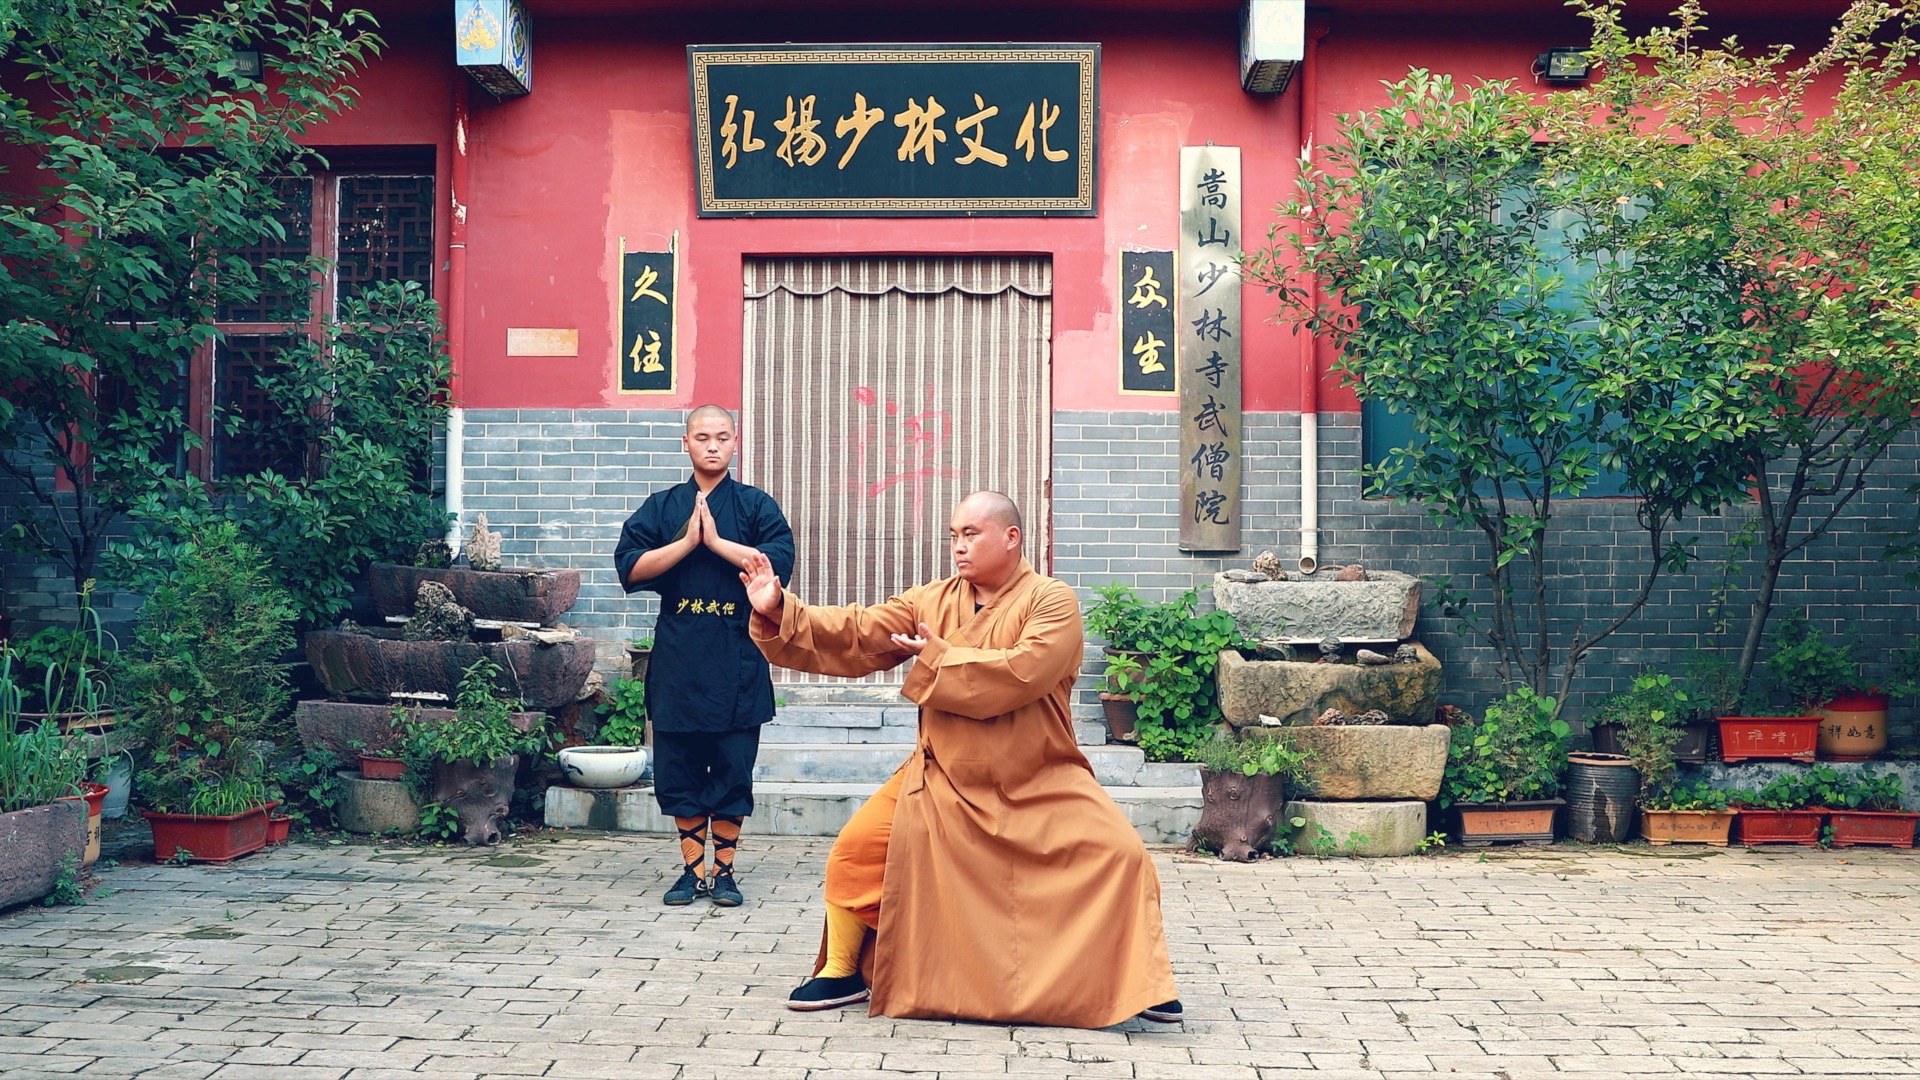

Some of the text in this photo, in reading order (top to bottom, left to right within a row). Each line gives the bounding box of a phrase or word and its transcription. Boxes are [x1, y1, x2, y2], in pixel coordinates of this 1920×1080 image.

[720, 92, 1070, 169] 弘揚少林文化
[630, 264, 669, 374] 久住
[1127, 266, 1168, 375] 众生
[1191, 168, 1232, 525] 嵩山少林寺武僧院
[676, 598, 736, 617] 少林武僧
[1819, 724, 1876, 740] 祥如意
